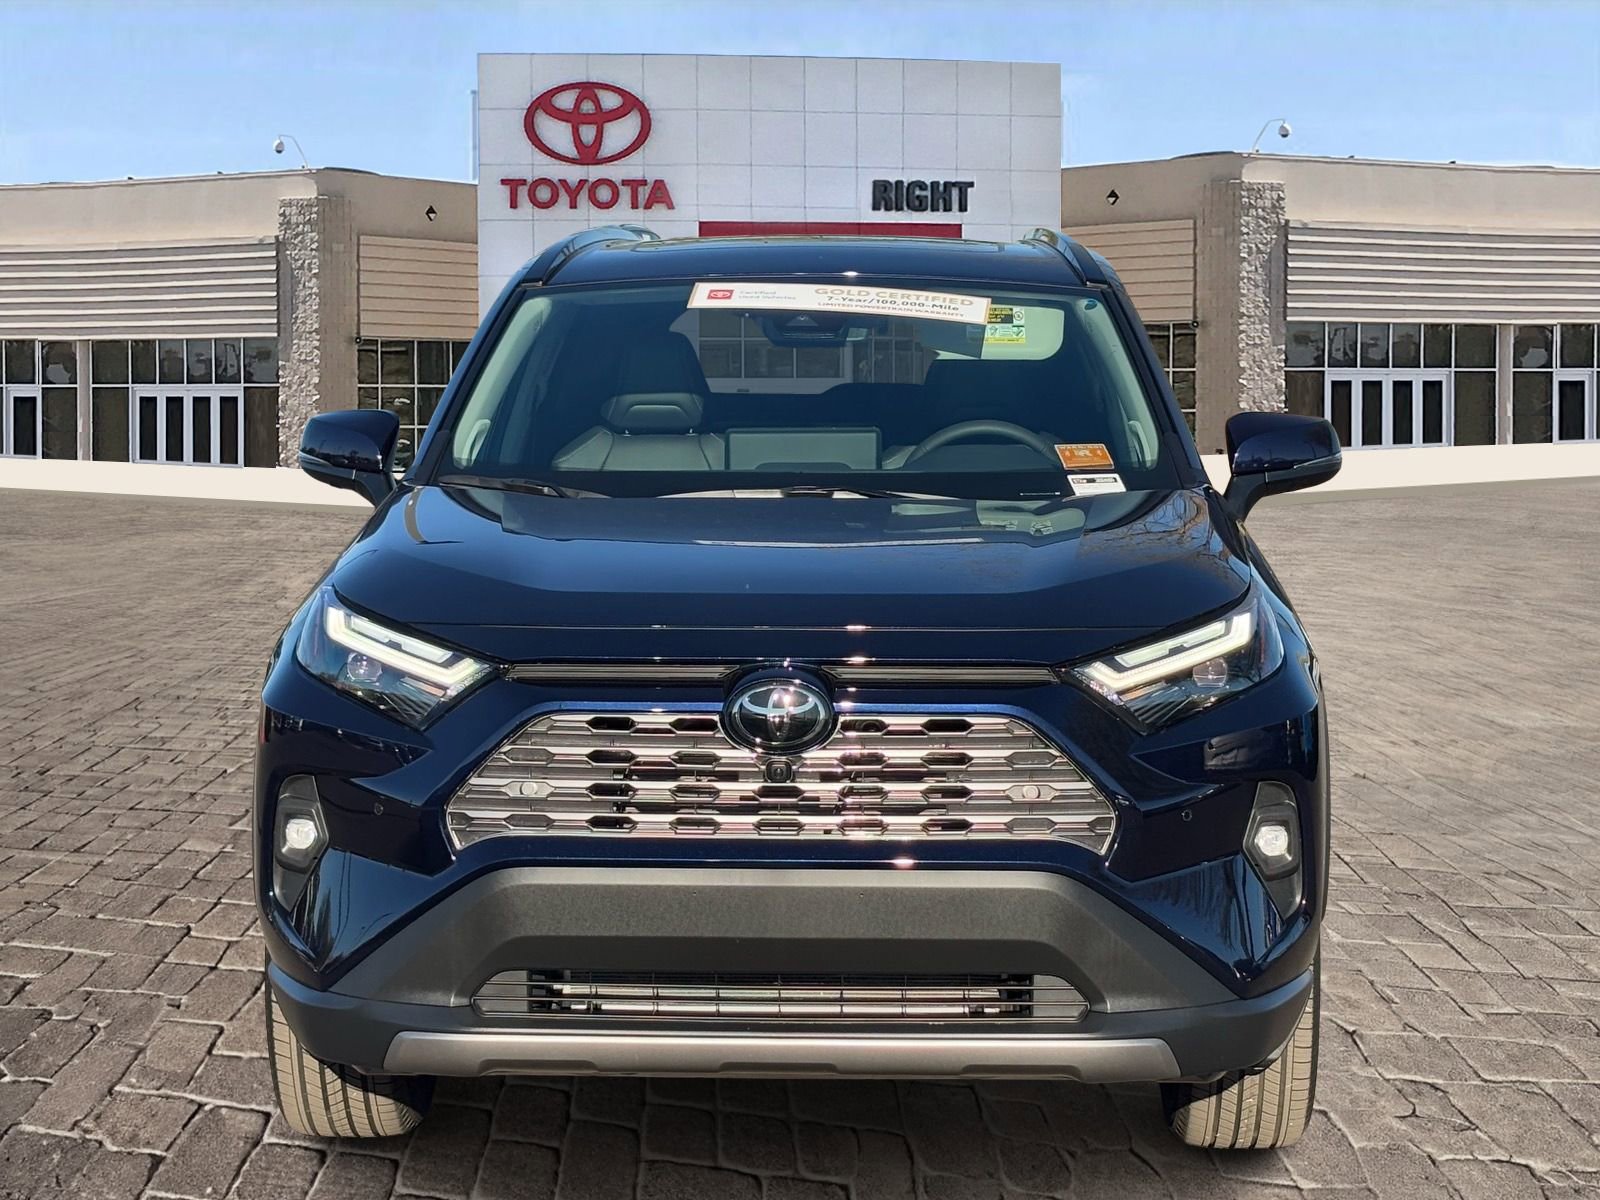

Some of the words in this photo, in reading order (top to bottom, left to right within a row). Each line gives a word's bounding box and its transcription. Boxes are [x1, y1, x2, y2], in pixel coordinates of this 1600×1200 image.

[500, 178, 675, 210] TOYOTA
[872, 179, 975, 212] RIGHT
[815, 288, 870, 297] GOLD
[876, 291, 974, 306] CERTIFIED
[826, 295, 960, 311] 7-Year/100,000-Mile
